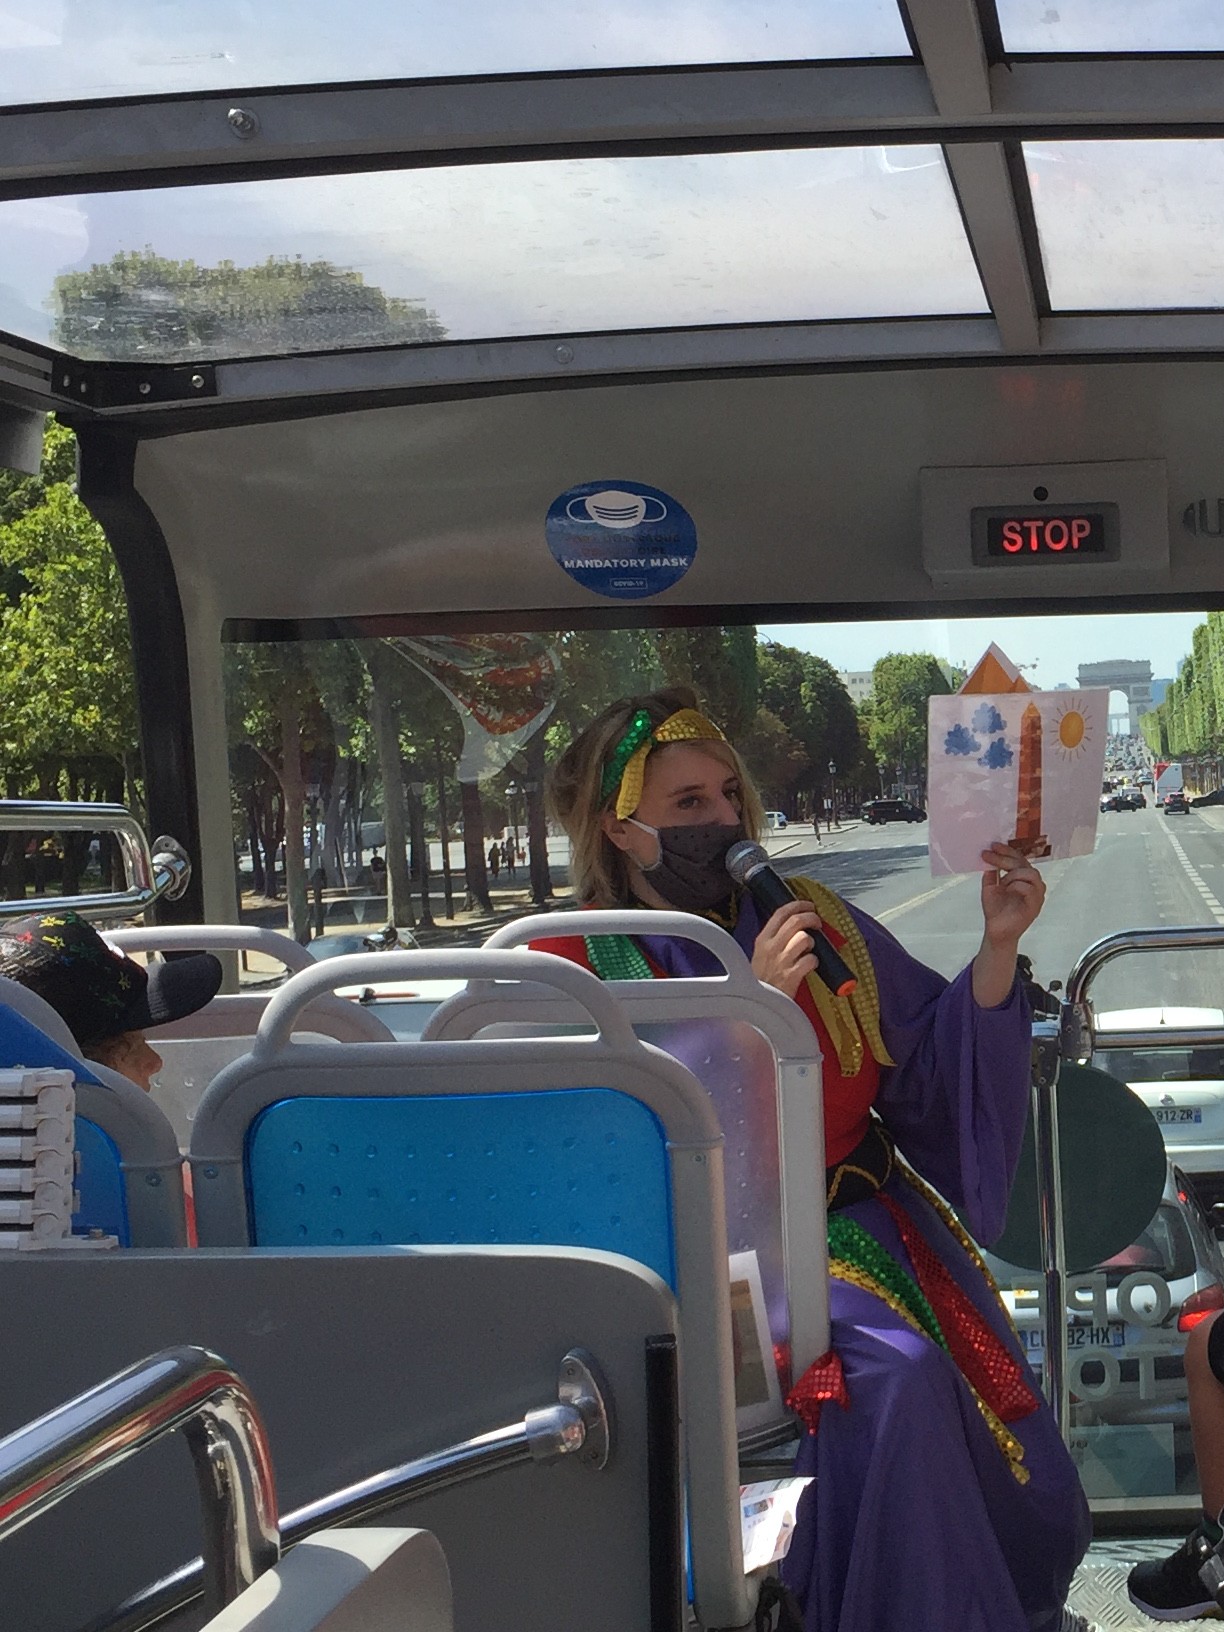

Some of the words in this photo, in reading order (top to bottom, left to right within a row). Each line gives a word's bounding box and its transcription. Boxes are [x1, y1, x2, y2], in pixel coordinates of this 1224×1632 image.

[1002, 519, 1092, 554] STOP
[564, 558, 647, 569] MANDATORY
[650, 557, 689, 568] MASK
[1156, 1109, 1193, 1121] 912-ZR
